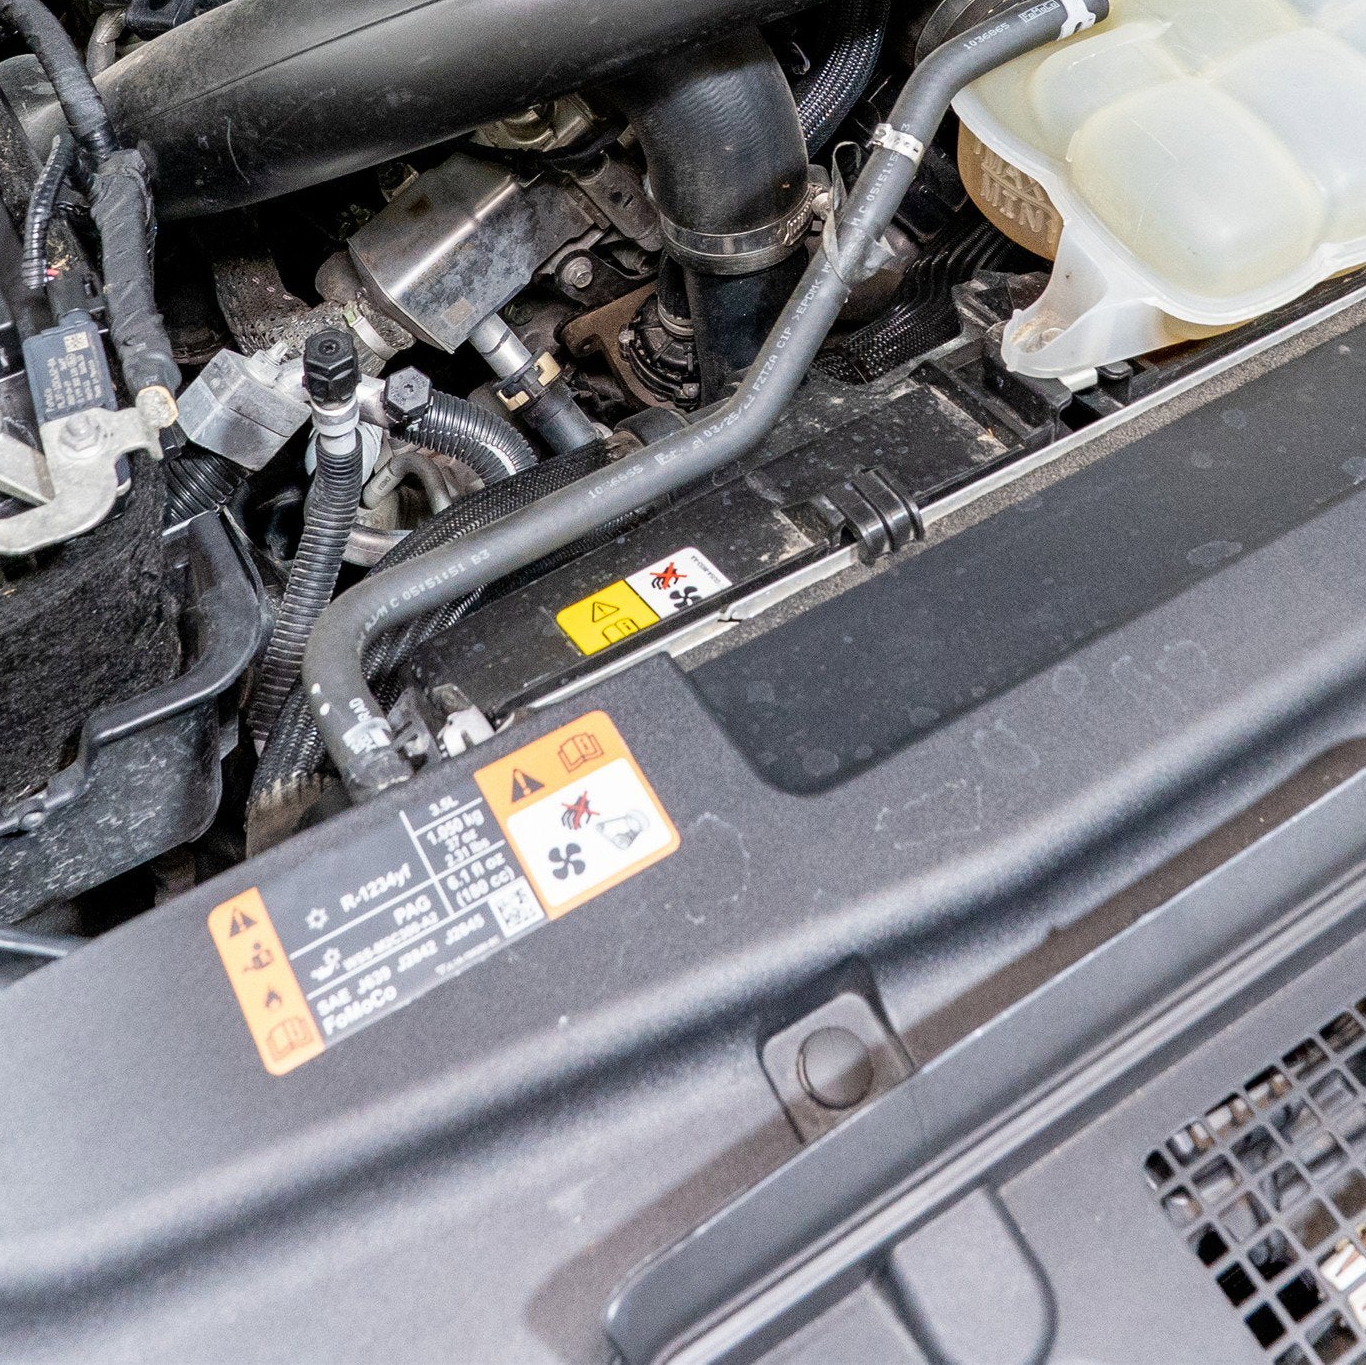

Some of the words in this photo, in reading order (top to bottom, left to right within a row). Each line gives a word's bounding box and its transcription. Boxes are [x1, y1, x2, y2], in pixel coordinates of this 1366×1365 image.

[963, 22, 1010, 50] 1036865
[979, 172, 1044, 234] MIN
[776, 327, 792, 349] CIP
[402, 561, 466, 600] 05:51:51
[462, 809, 485, 827] kg
[485, 852, 505, 870] oz
[339, 863, 411, 912] R-1234yf
[393, 895, 431, 925] PAG
[317, 987, 352, 1016] SAE
[322, 985, 397, 1036] FoMoCo
